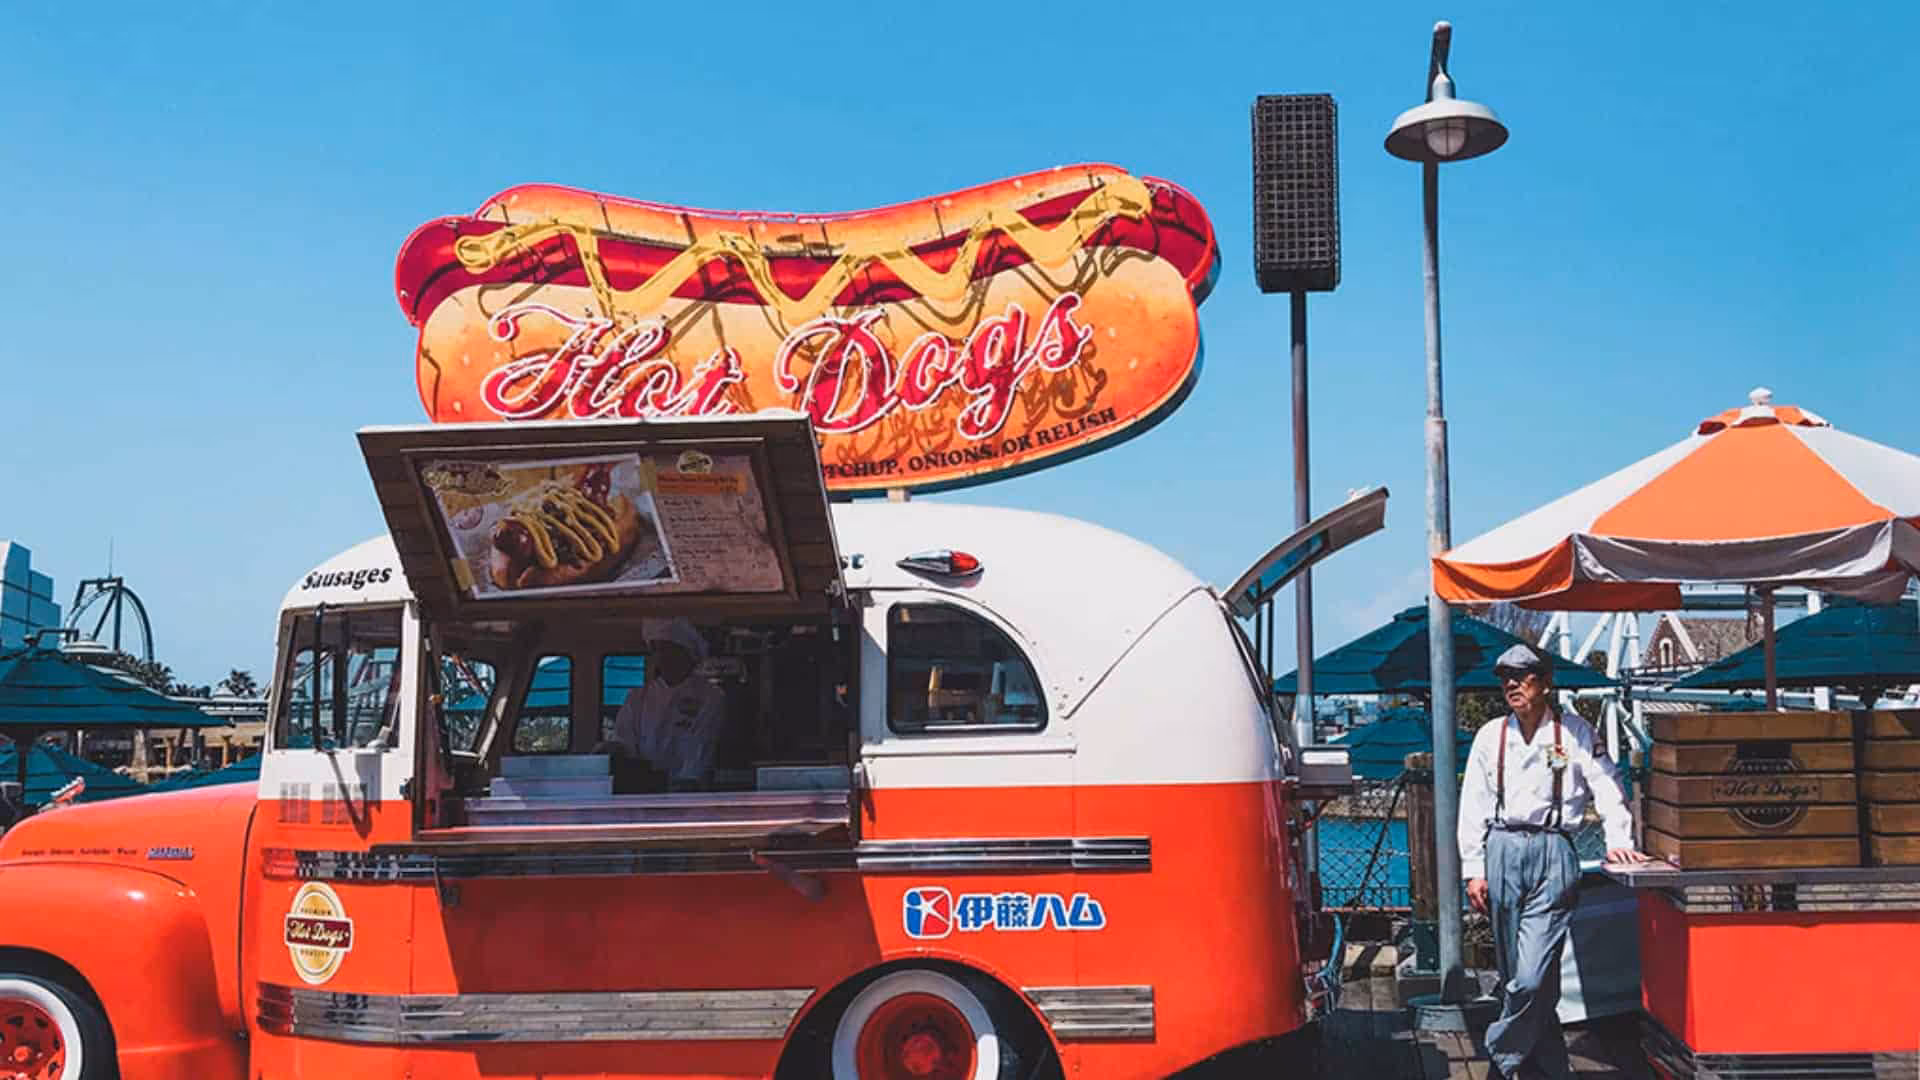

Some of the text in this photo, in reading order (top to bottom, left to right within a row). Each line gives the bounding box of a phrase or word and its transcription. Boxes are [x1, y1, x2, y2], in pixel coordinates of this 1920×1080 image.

[480, 292, 1093, 440] Hot Dogs
[823, 460, 903, 479] TCHUP,
[1002, 434, 1033, 455] OR
[1037, 407, 1116, 445] RELISH
[302, 567, 393, 591] Sausages
[1762, 781, 1810, 799] Dogs
[955, 893, 1107, 932] 伊藤ハム
[288, 920, 344, 947] Hot Dogs
